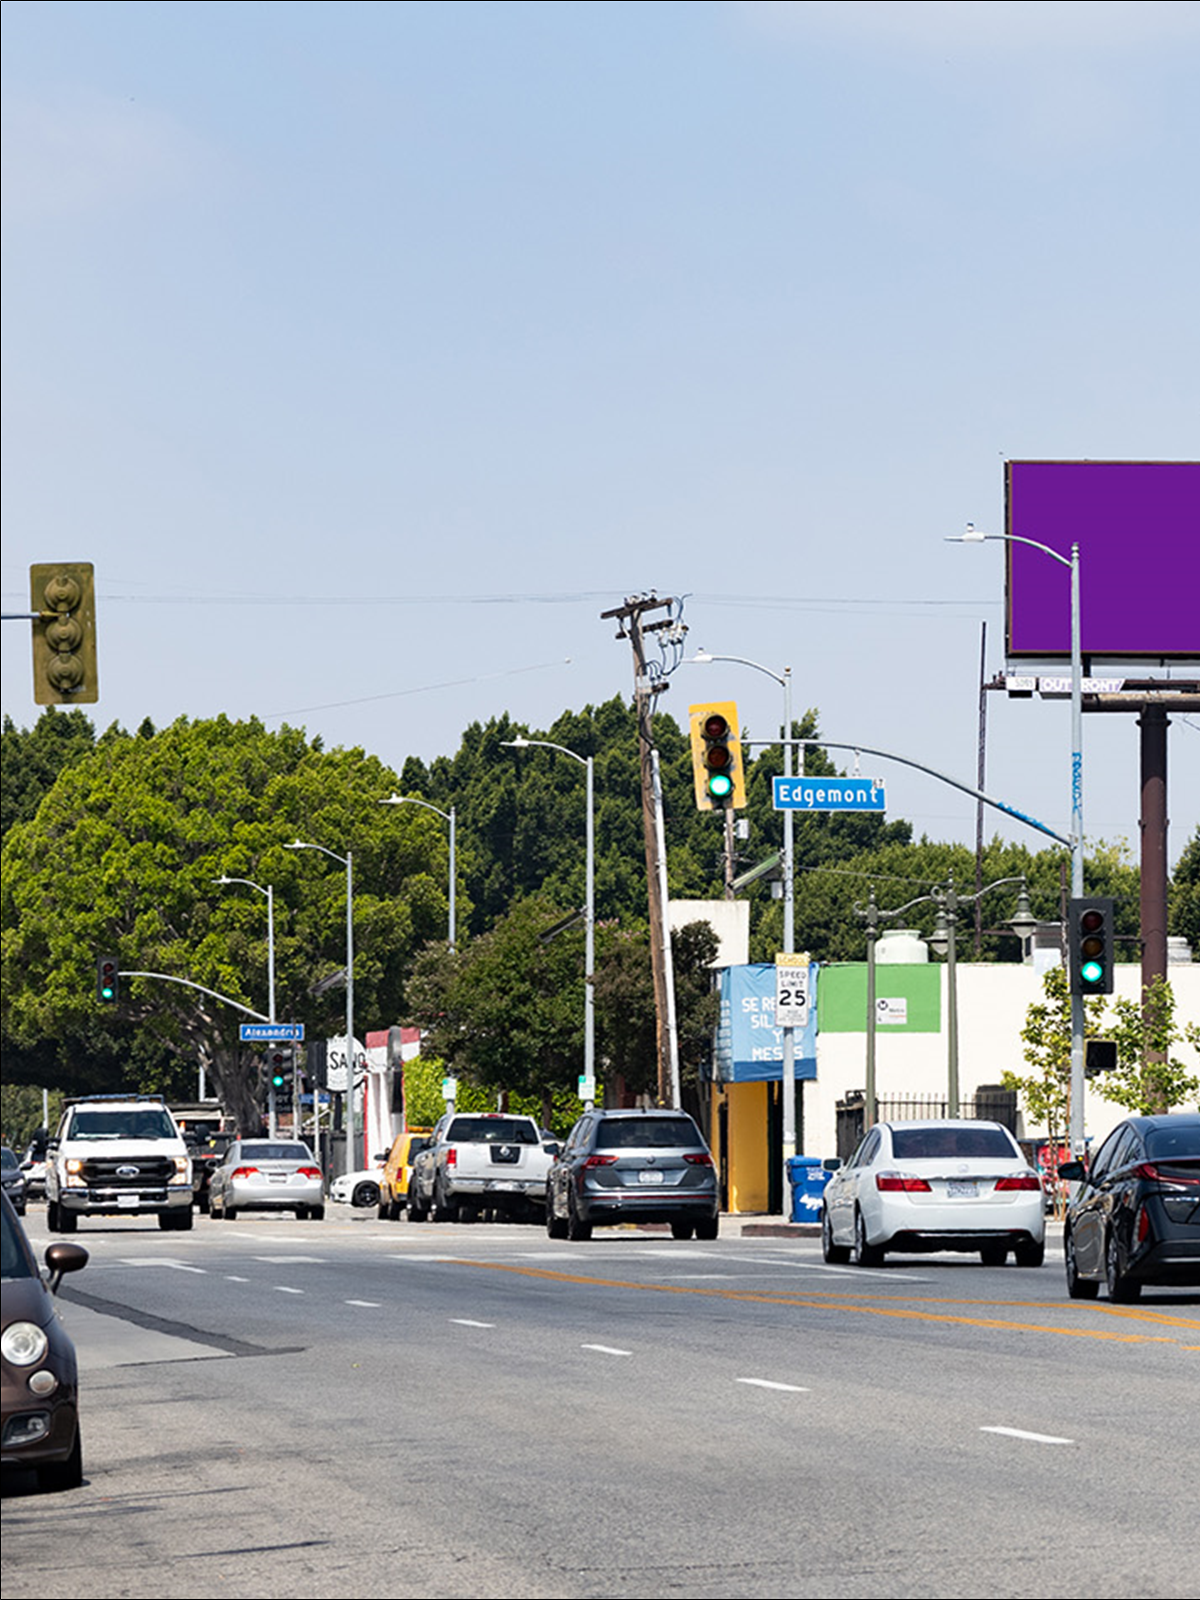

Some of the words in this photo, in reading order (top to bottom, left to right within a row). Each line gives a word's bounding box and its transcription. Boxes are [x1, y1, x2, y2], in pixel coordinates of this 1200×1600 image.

[1041, 679, 1121, 692] OUTRONT
[779, 785, 878, 807] Edgemont
[779, 971, 807, 979] SPEED
[781, 980, 804, 988] LIMIT
[741, 997, 759, 1012] SE
[779, 989, 806, 1006] 25
[752, 1046, 804, 1061] MESS
